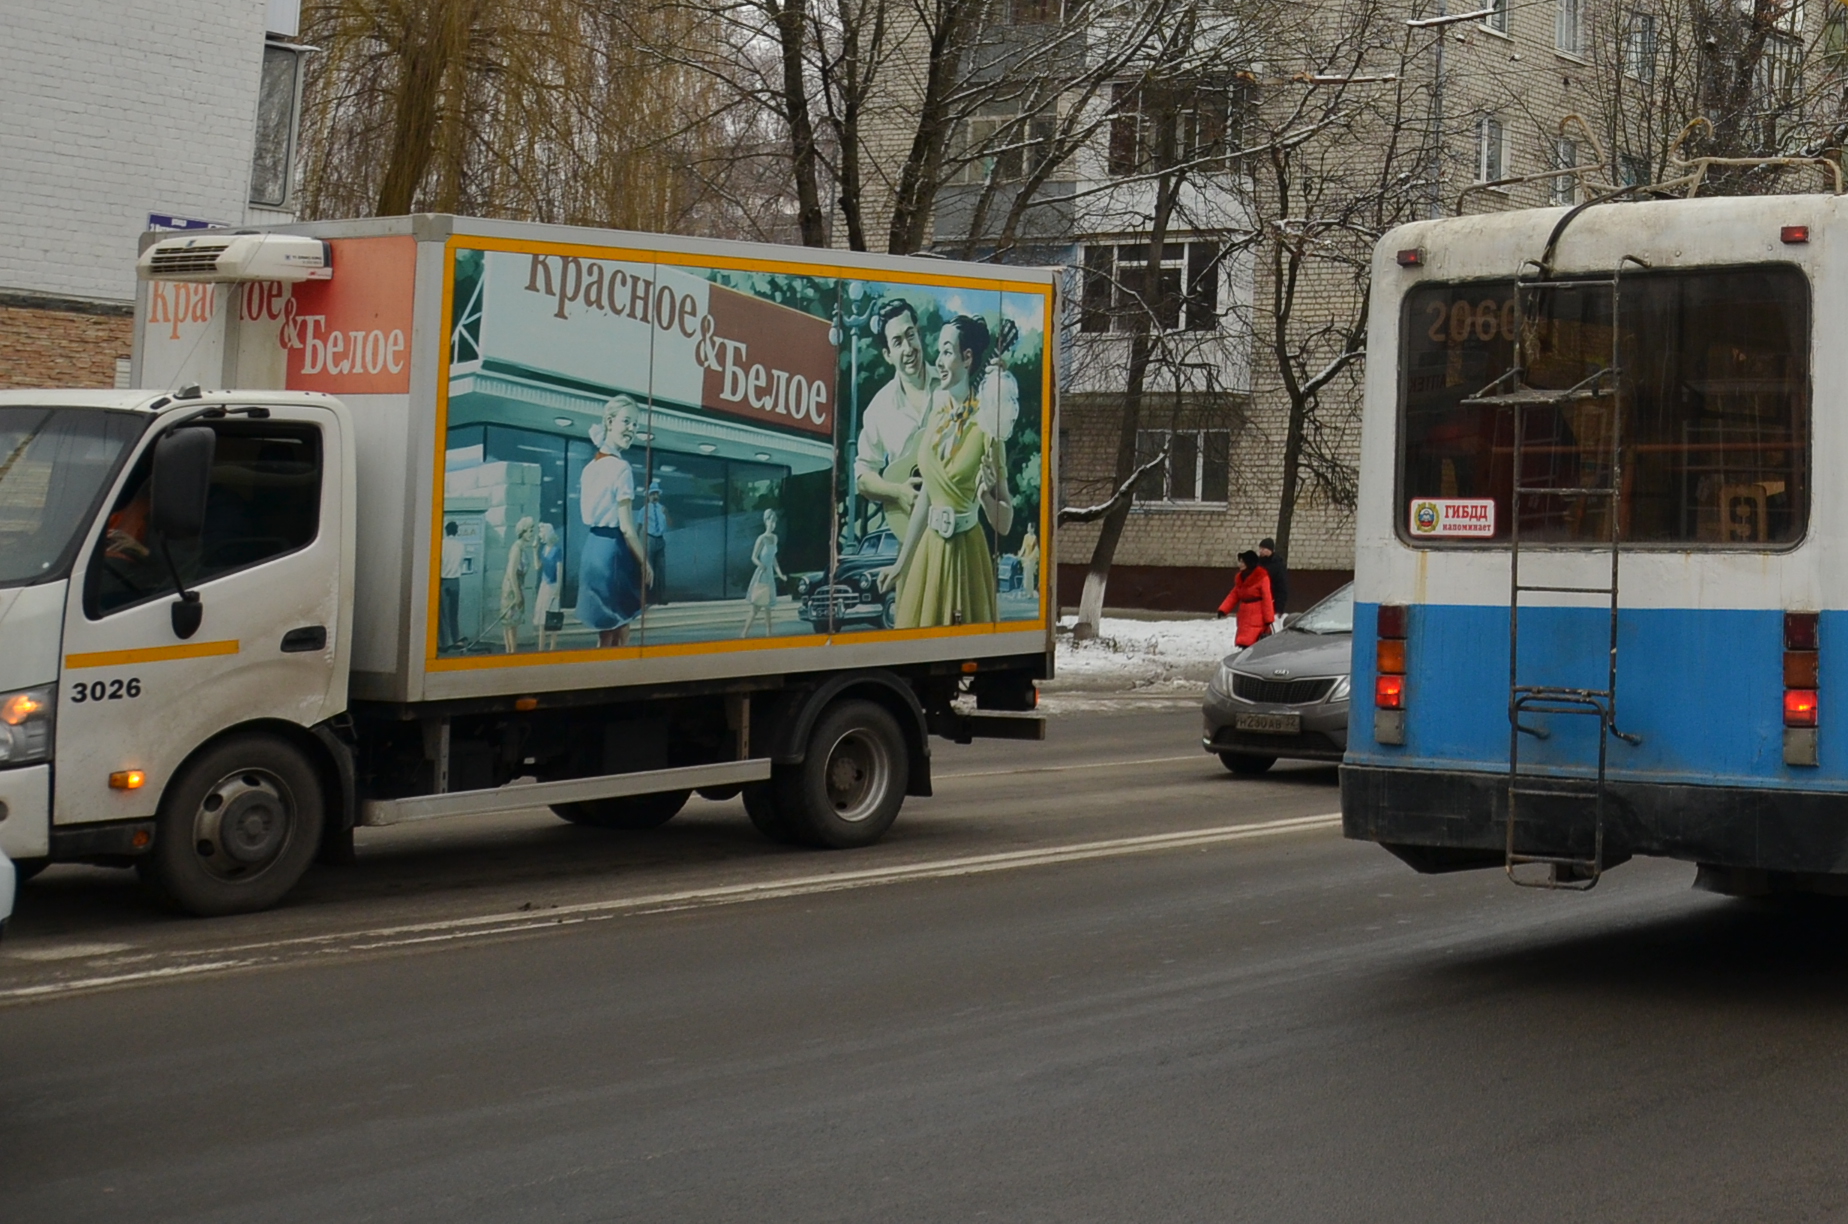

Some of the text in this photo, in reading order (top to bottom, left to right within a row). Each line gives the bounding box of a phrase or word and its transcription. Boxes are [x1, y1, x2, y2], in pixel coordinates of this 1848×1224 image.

[149, 280, 404, 375] Краое & Белое
[524, 253, 827, 425] Красное & Белое
[1426, 299, 1523, 342] 2060
[1445, 505, 1488, 521] ГИБДД
[71, 678, 142, 703] 3026
